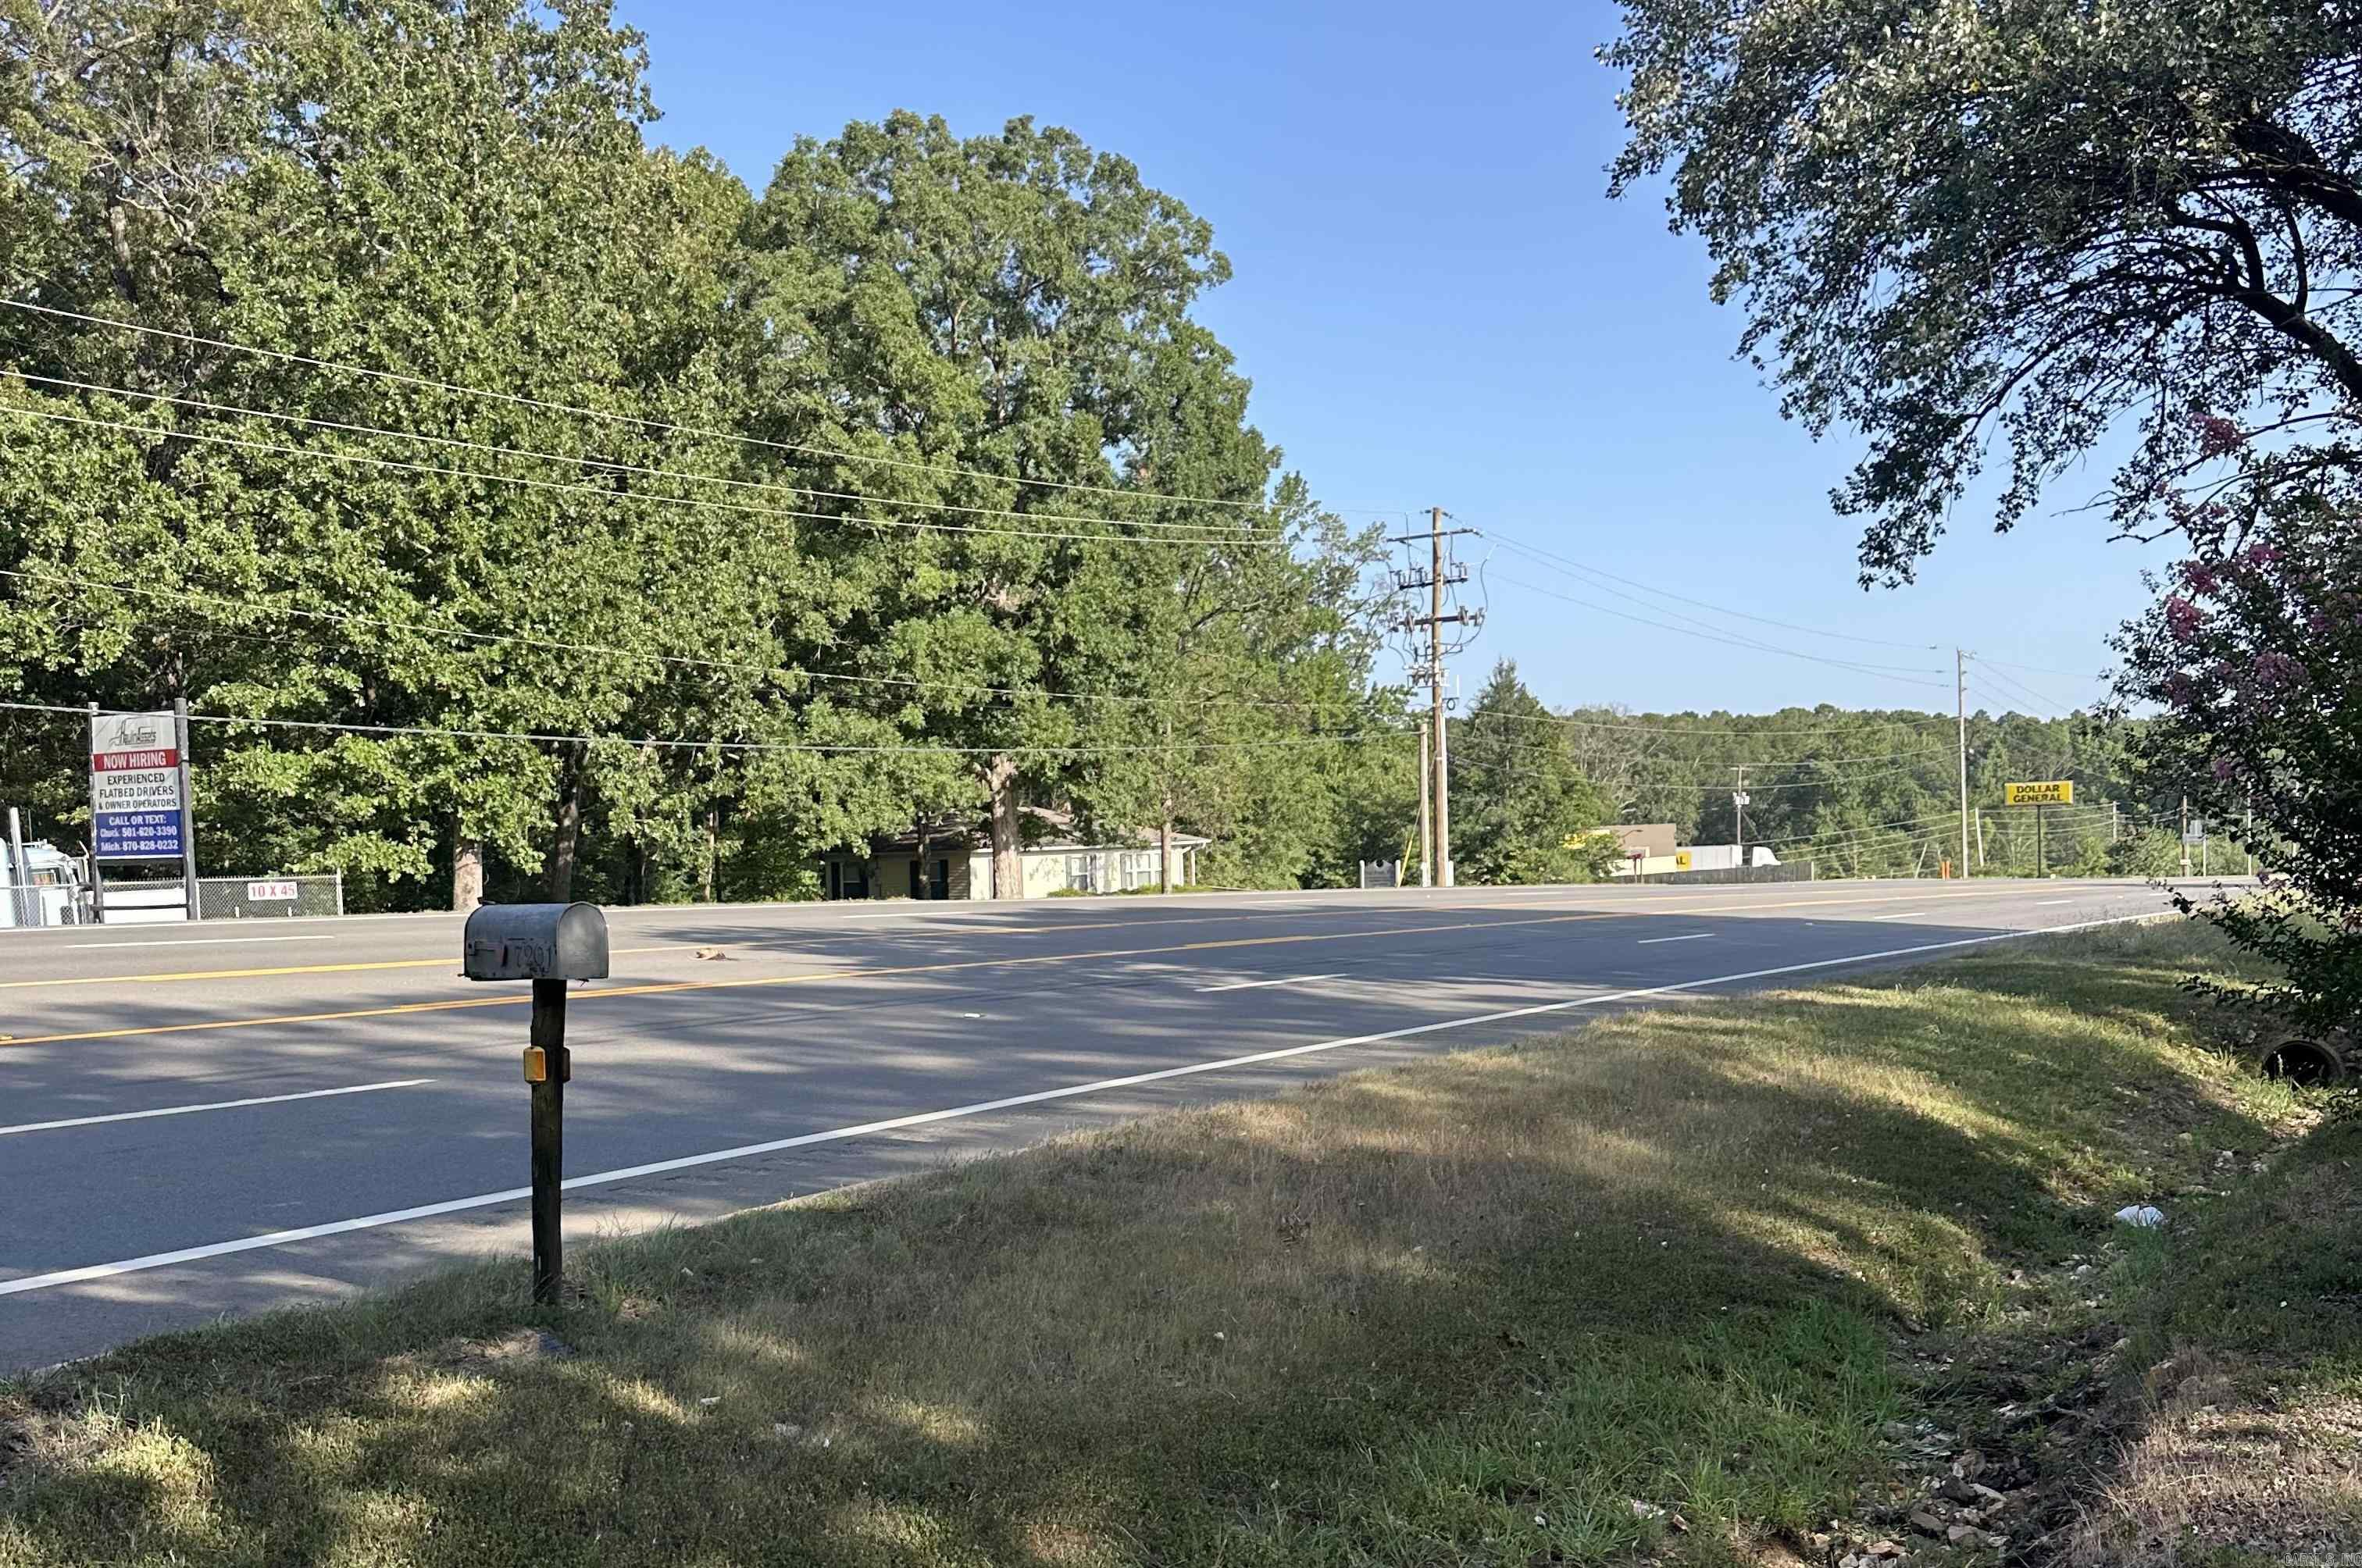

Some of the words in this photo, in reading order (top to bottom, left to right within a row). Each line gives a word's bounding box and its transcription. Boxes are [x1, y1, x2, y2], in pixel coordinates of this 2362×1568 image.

[104, 754, 127, 769] NOW
[129, 751, 167, 768] HIRING
[107, 773, 165, 785] EXPERIENCED
[99, 788, 134, 799] FLATBED
[137, 786, 174, 796] DRIVERS
[2016, 784, 2060, 793] DOLLAR
[105, 800, 130, 810] OWNER
[132, 798, 177, 808] OPERATORS
[2013, 793, 2064, 803] GENERAL
[109, 816, 130, 825] CALL
[130, 815, 143, 825] OR
[144, 814, 166, 824] TEXT:
[252, 886, 266, 897] 10
[269, 886, 277, 896] X
[281, 885, 294, 896] 45
